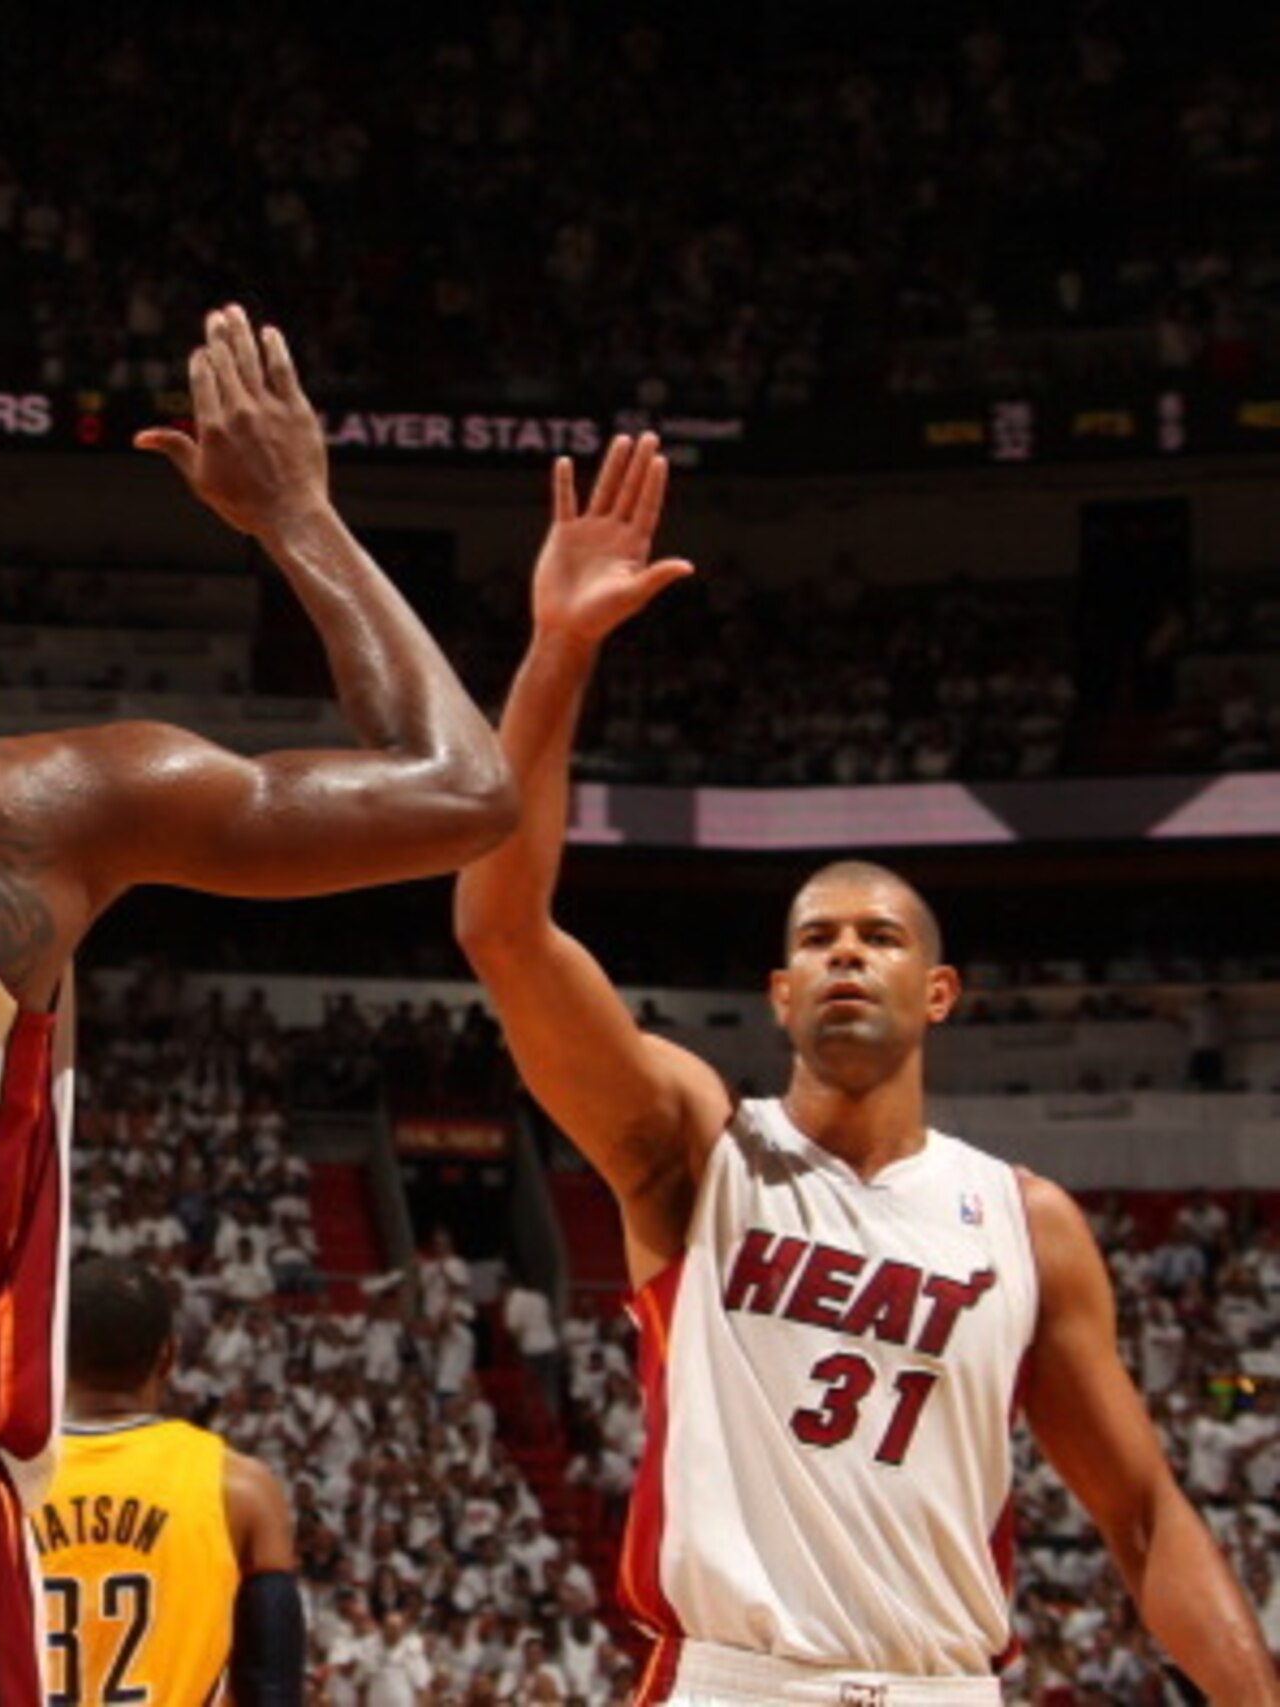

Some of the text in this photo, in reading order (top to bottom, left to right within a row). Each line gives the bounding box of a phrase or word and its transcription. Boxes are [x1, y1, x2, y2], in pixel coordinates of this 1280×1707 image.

[459, 415, 600, 456] STATS
[723, 1228, 996, 1357] HEAT
[790, 1353, 940, 1466] 31
[31, 1495, 169, 1556] ATSON
[44, 1574, 153, 1706] 32
